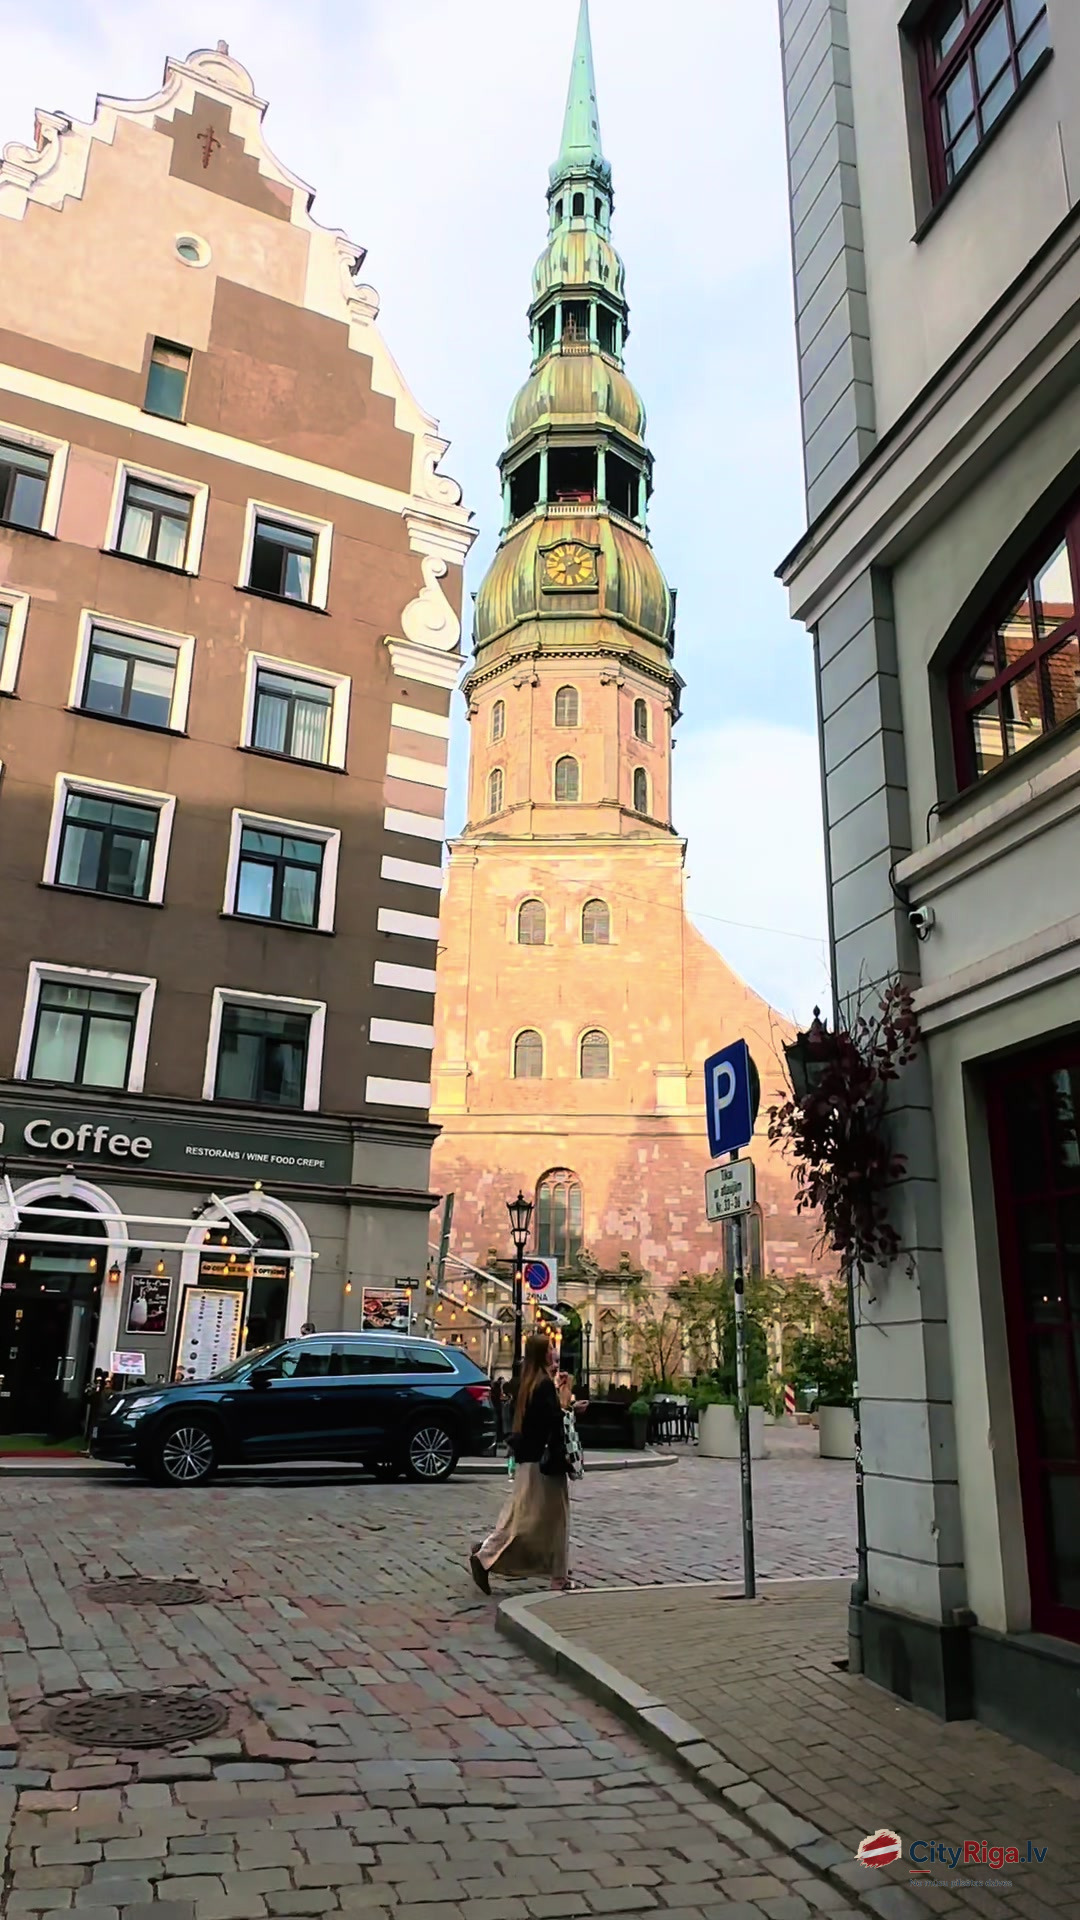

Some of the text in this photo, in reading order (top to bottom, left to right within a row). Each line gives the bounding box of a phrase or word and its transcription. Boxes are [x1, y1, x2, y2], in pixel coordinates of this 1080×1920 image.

[713, 1061, 736, 1141] P
[24, 1119, 153, 1158] Coffee
[246, 1152, 269, 1162] WINE
[270, 1156, 295, 1165] FOOD
[296, 1158, 325, 1168] CREPE
